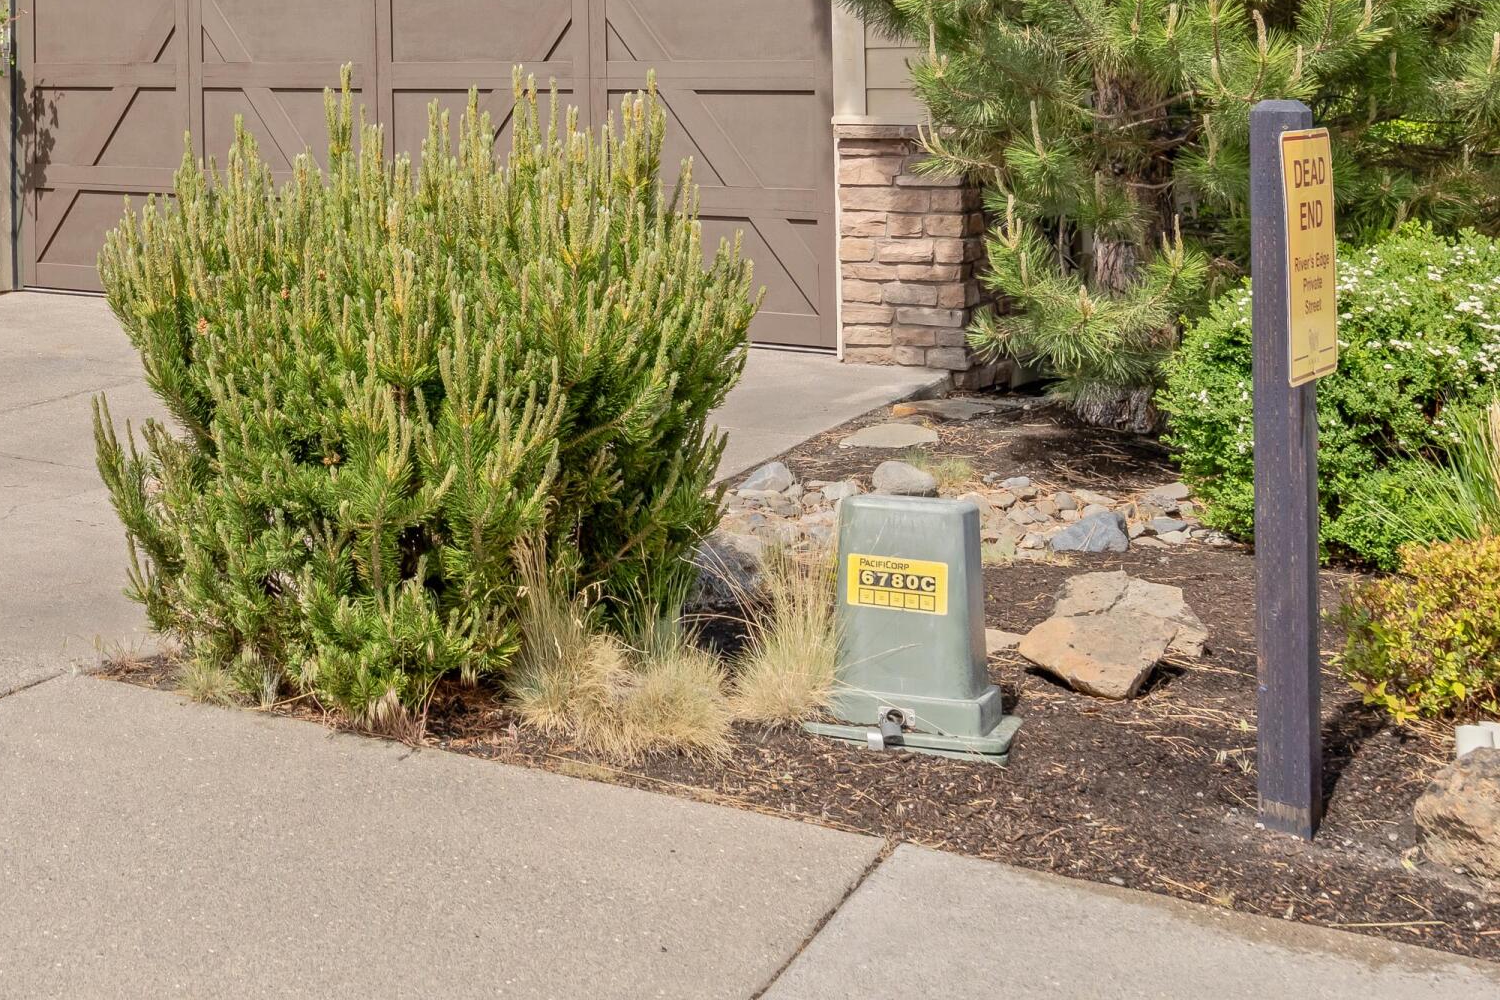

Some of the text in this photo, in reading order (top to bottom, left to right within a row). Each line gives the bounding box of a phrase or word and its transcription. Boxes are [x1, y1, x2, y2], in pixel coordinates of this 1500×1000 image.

[1294, 157, 1325, 188] DEAD
[1300, 199, 1323, 230] END
[1294, 252, 1329, 272] River's Edge
[1303, 276, 1322, 293] Private
[1305, 299, 1321, 314] Street
[861, 570, 935, 592] 6780C
